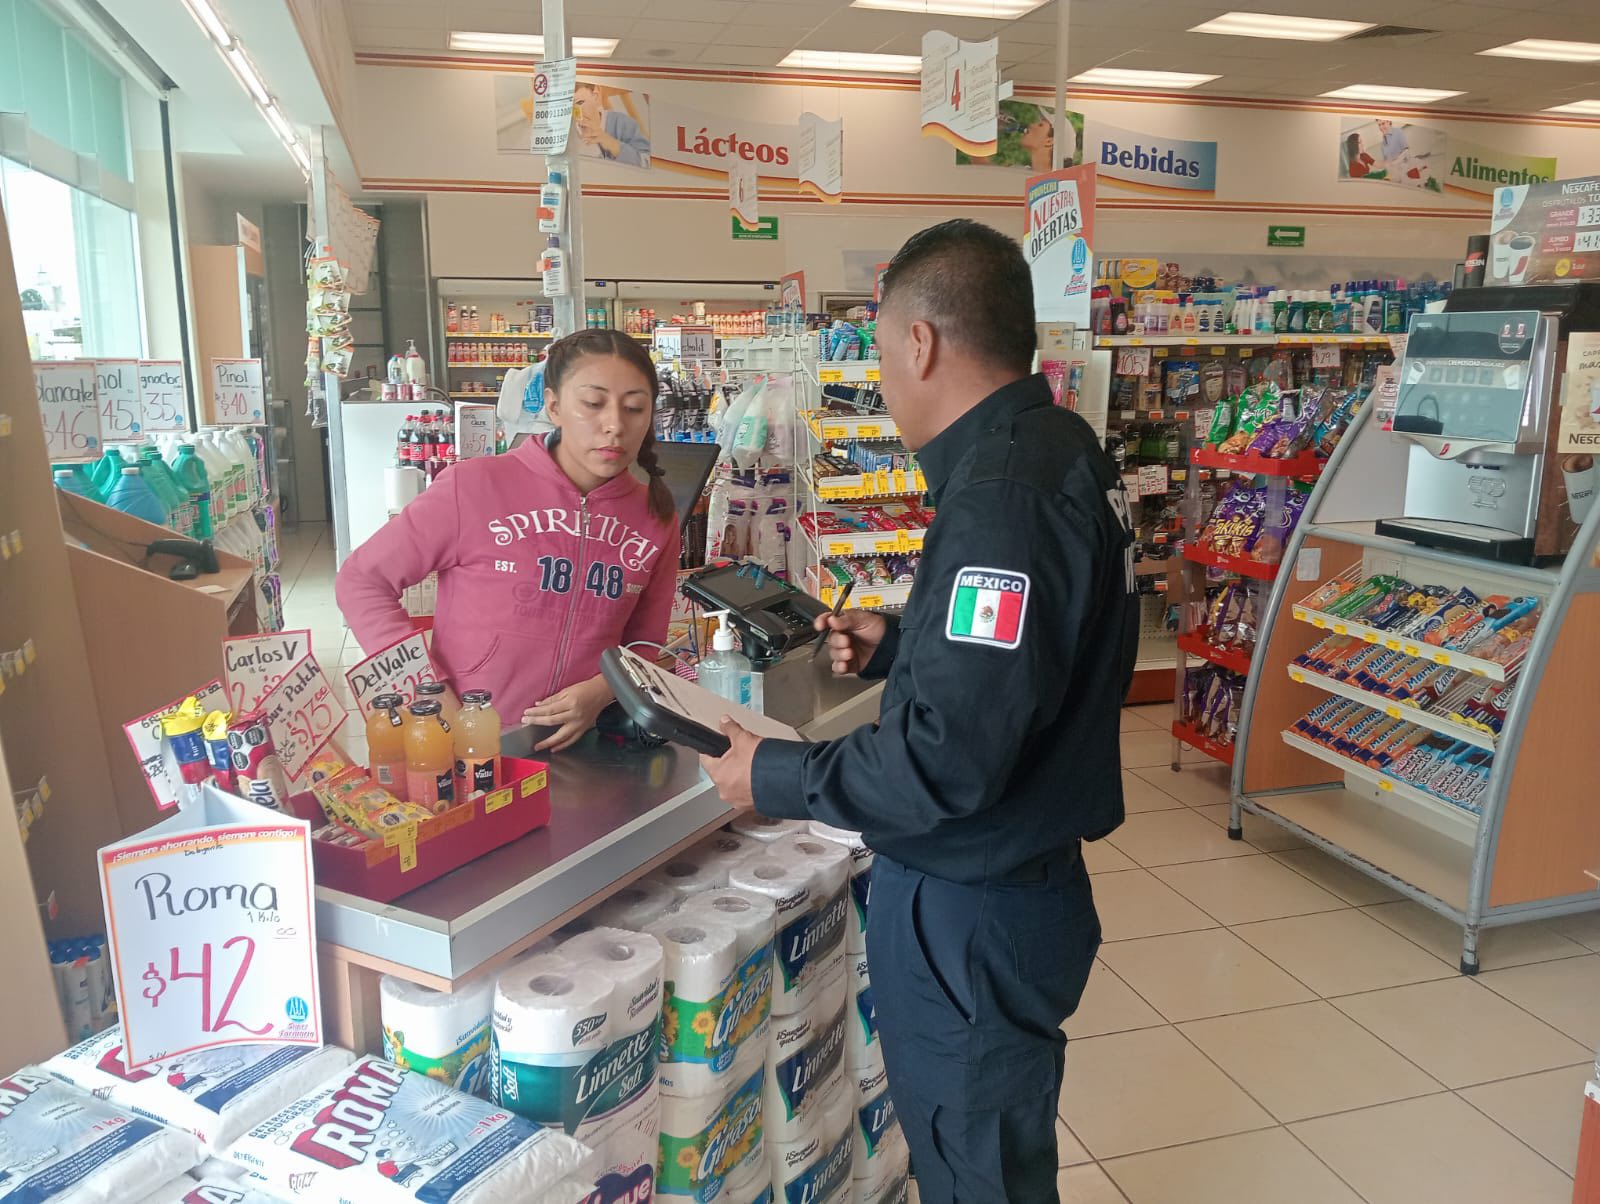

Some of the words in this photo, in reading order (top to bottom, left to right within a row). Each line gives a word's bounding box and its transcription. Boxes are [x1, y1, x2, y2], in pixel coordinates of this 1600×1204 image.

[951, 68, 961, 112] 4
[677, 126, 789, 165] Lácteos
[1101, 141, 1200, 178] Bebidas
[1451, 156, 1549, 185] Alimentos
[1031, 208, 1078, 258] OFERTAS
[1033, 190, 1075, 237] NUESTRAS
[216, 364, 248, 384] Pinol
[101, 399, 134, 431] 45
[488, 508, 660, 573] SPIRITUAL
[494, 560, 518, 574] EST.
[537, 555, 574, 594] 18
[584, 560, 625, 600] 48
[225, 645, 284, 673] Carlos
[282, 640, 298, 660] V
[283, 661, 321, 702] Patch
[218, 830, 257, 842] siempre
[257, 828, 298, 838] contigo!
[134, 871, 278, 921] Roma
[142, 935, 275, 1036] $42
[573, 1019, 596, 1037] 350
[503, 1064, 519, 1104] Soft
[575, 1029, 650, 1105] Linnette
[618, 1061, 645, 1100] Soft
[102, 1117, 127, 1128] kg
[247, 1099, 309, 1138] DETERGENTE
[256, 1088, 336, 1140] BIODEGRADABLE
[291, 1060, 410, 1170] ROMA
[485, 1112, 509, 1123] kg
